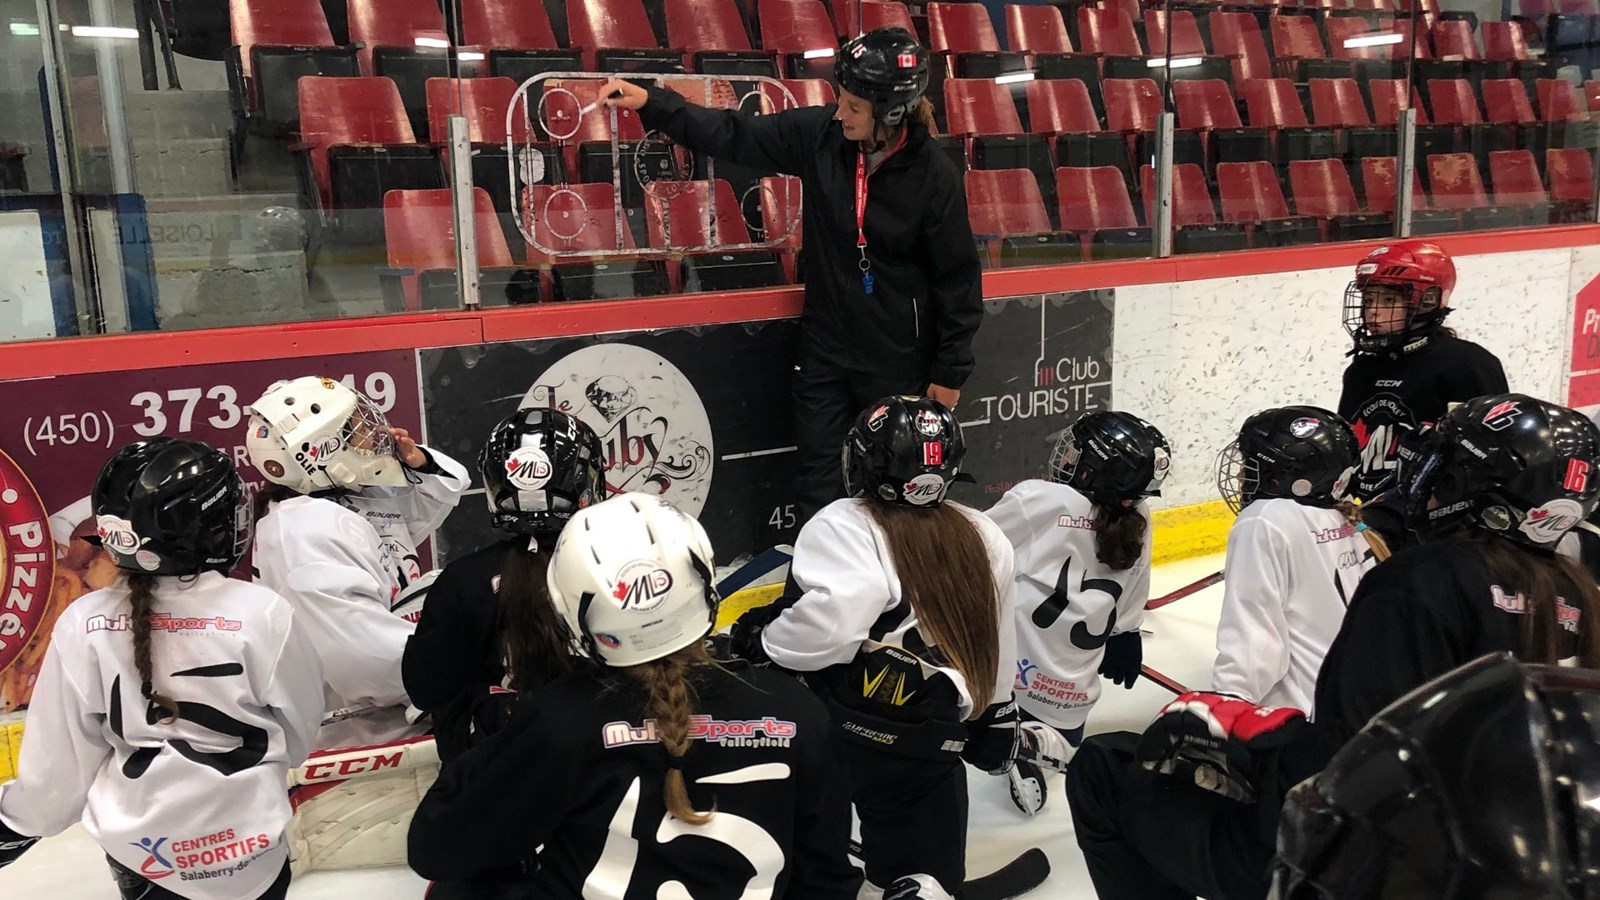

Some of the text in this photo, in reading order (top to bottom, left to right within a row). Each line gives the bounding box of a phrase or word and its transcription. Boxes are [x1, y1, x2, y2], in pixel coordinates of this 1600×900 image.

[1056, 356, 1100, 382] Club
[981, 381, 1111, 424] TOURISTE
[23, 410, 115, 456] (450)
[923, 441, 942, 466] 19
[1563, 457, 1589, 493] 16
[365, 511, 402, 519] BAUER
[884, 648, 918, 666] BAUER
[1031, 681, 1089, 702] SPORTIFS
[1036, 672, 1076, 690] CENTRES
[110, 662, 269, 779] 15
[687, 714, 796, 742] Sports
[719, 737, 790, 748] Valleyfield
[305, 752, 403, 780] CCM
[171, 828, 236, 853] CENTRES
[175, 833, 270, 869] SPORTIFS
